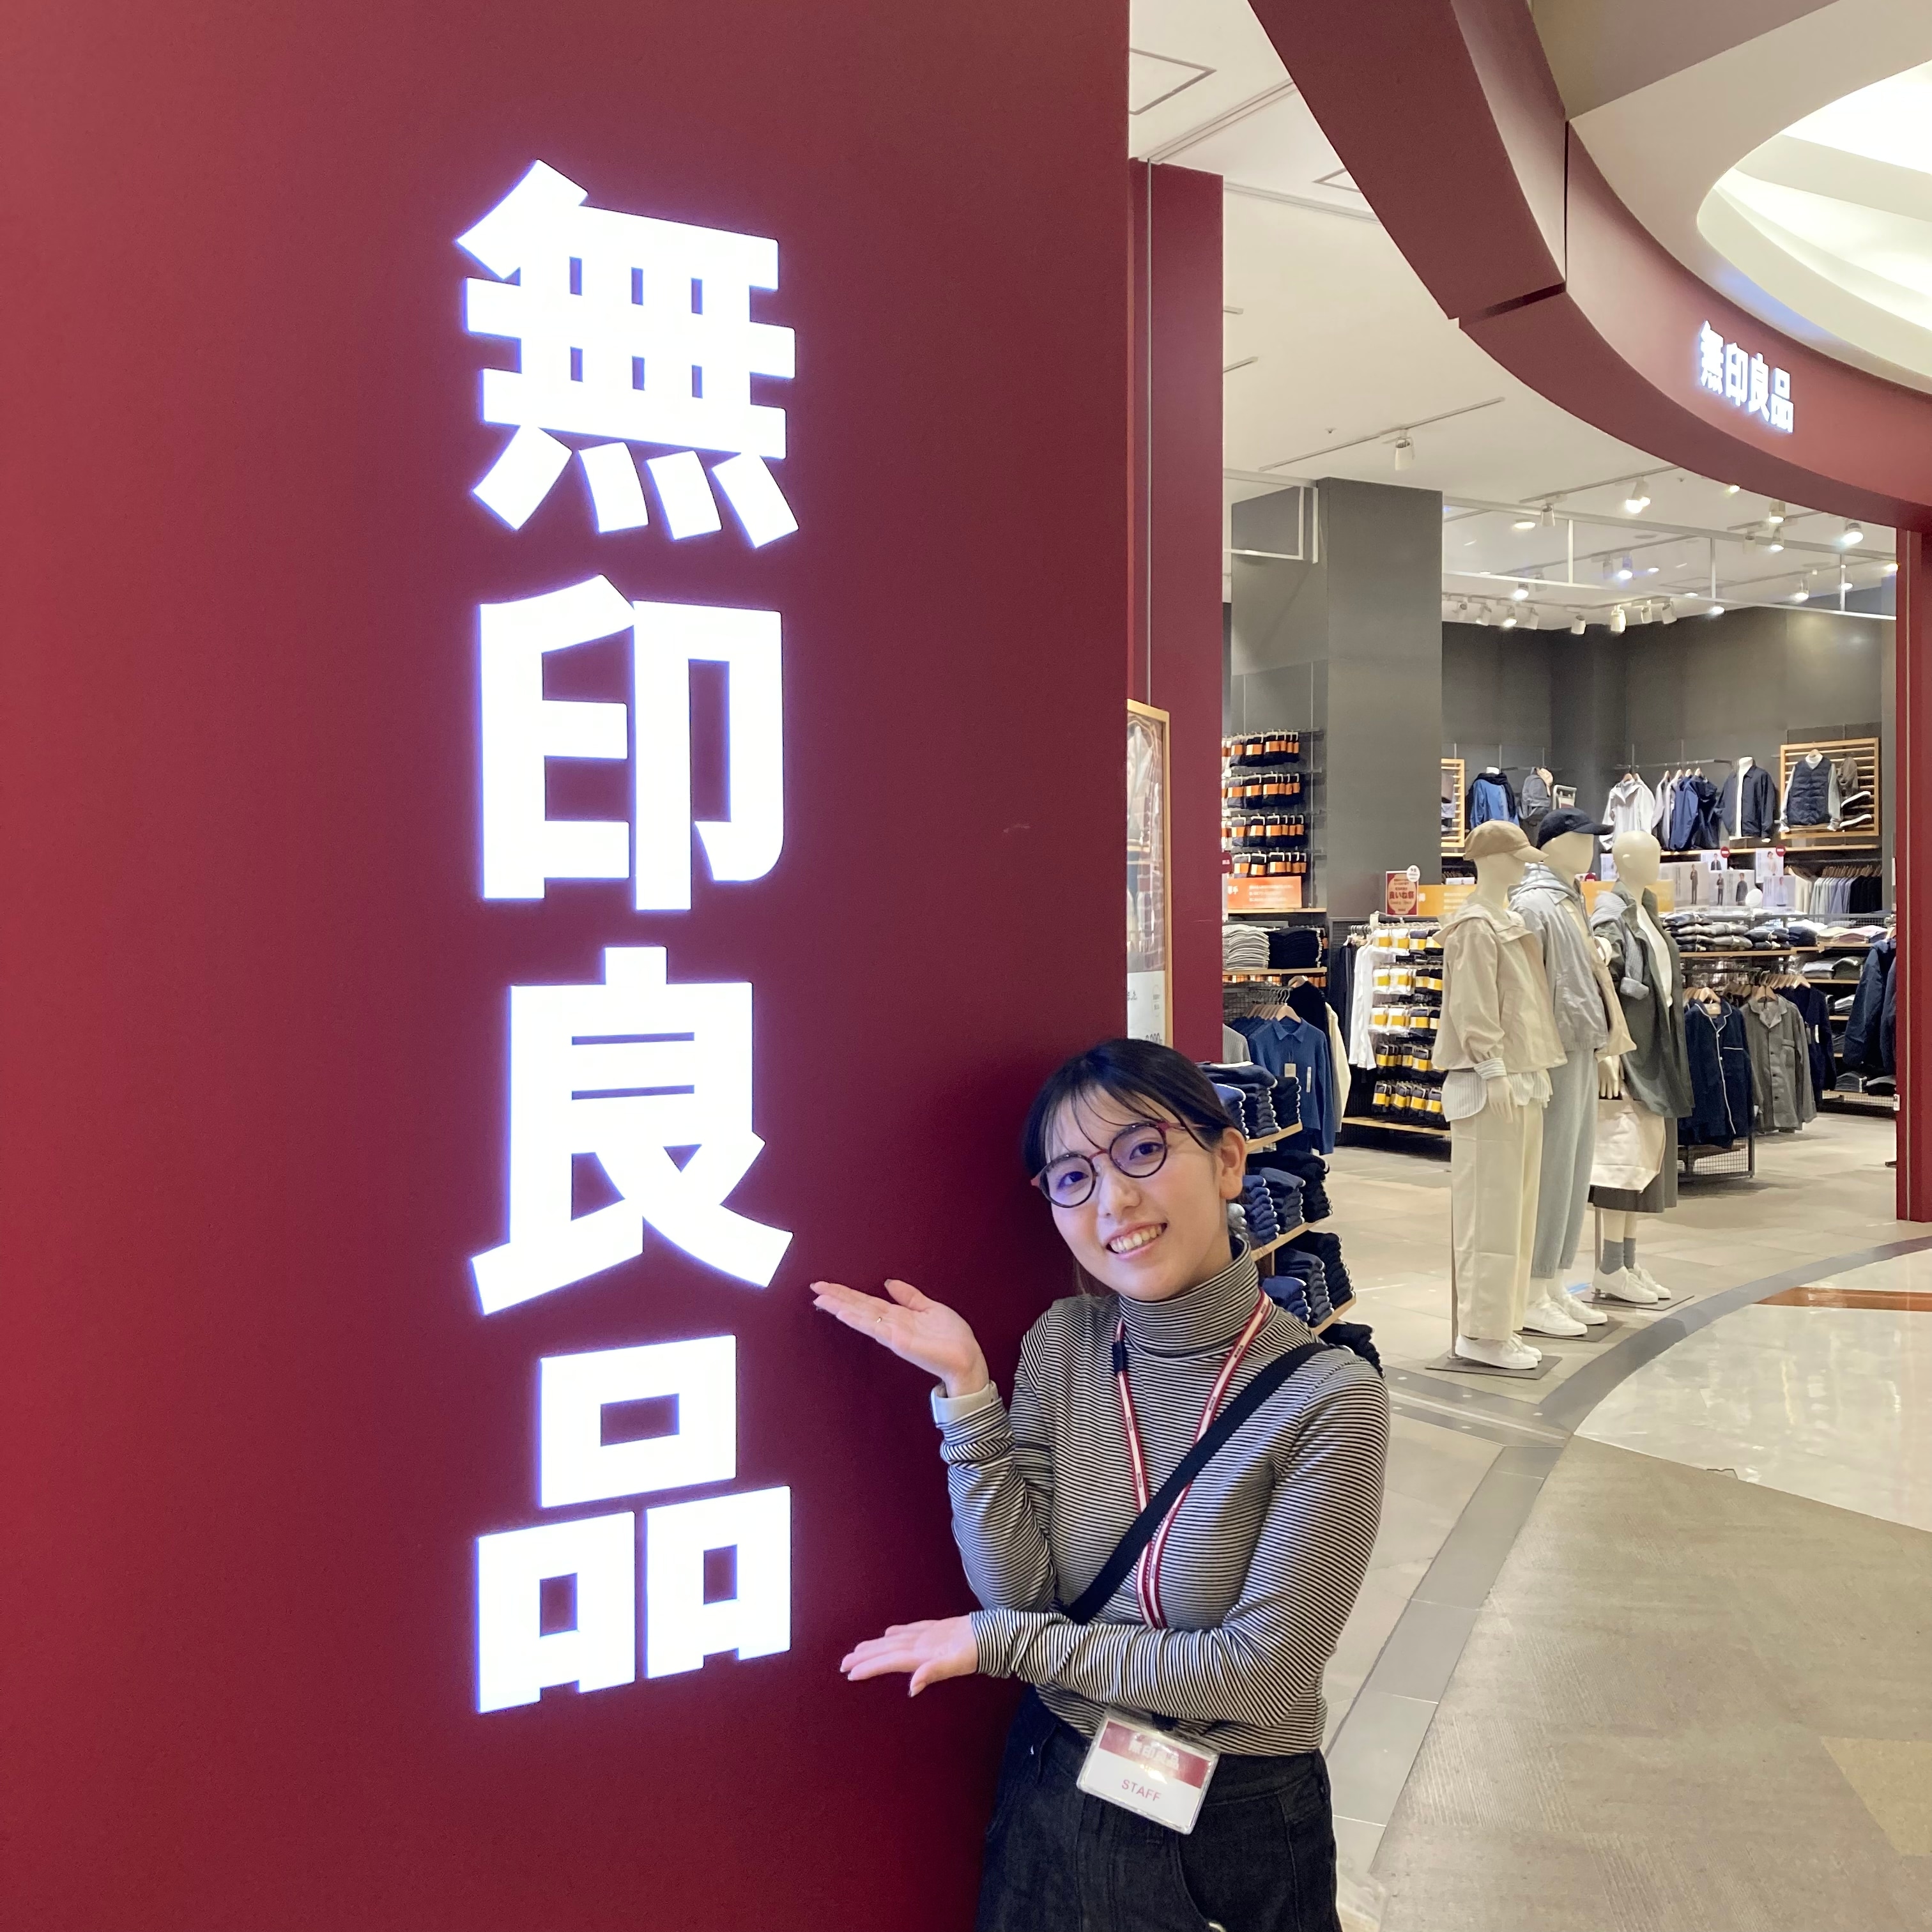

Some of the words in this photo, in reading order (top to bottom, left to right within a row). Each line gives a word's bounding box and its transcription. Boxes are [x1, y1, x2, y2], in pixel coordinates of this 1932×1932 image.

[1700, 320, 1794, 434] 無印良品
[456, 159, 799, 1712] 無印良品
[1122, 1780, 1161, 1801] STAFF
